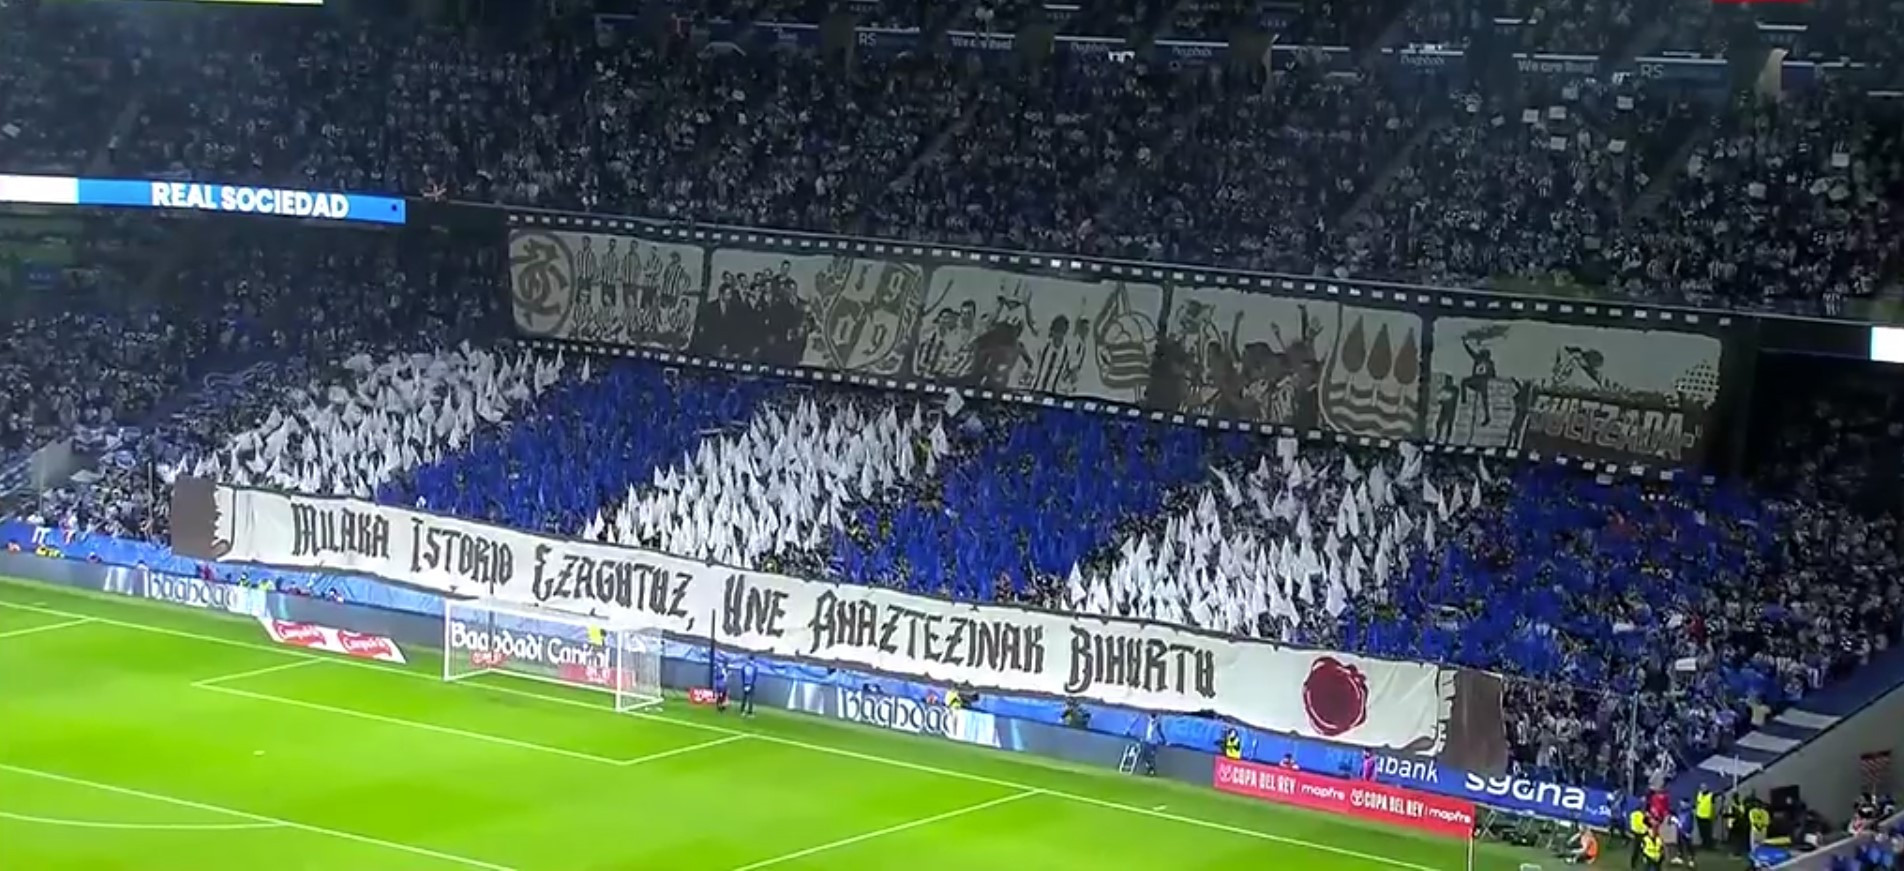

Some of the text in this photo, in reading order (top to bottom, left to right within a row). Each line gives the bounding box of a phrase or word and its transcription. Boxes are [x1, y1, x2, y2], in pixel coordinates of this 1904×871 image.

[1641, 64, 1664, 79] RS
[152, 181, 350, 220] REAL SOCIEDAD
[1232, 768, 1346, 801] COPA DEL REY mapfre
[1364, 792, 1472, 825] COPA DEL REY mapfre
